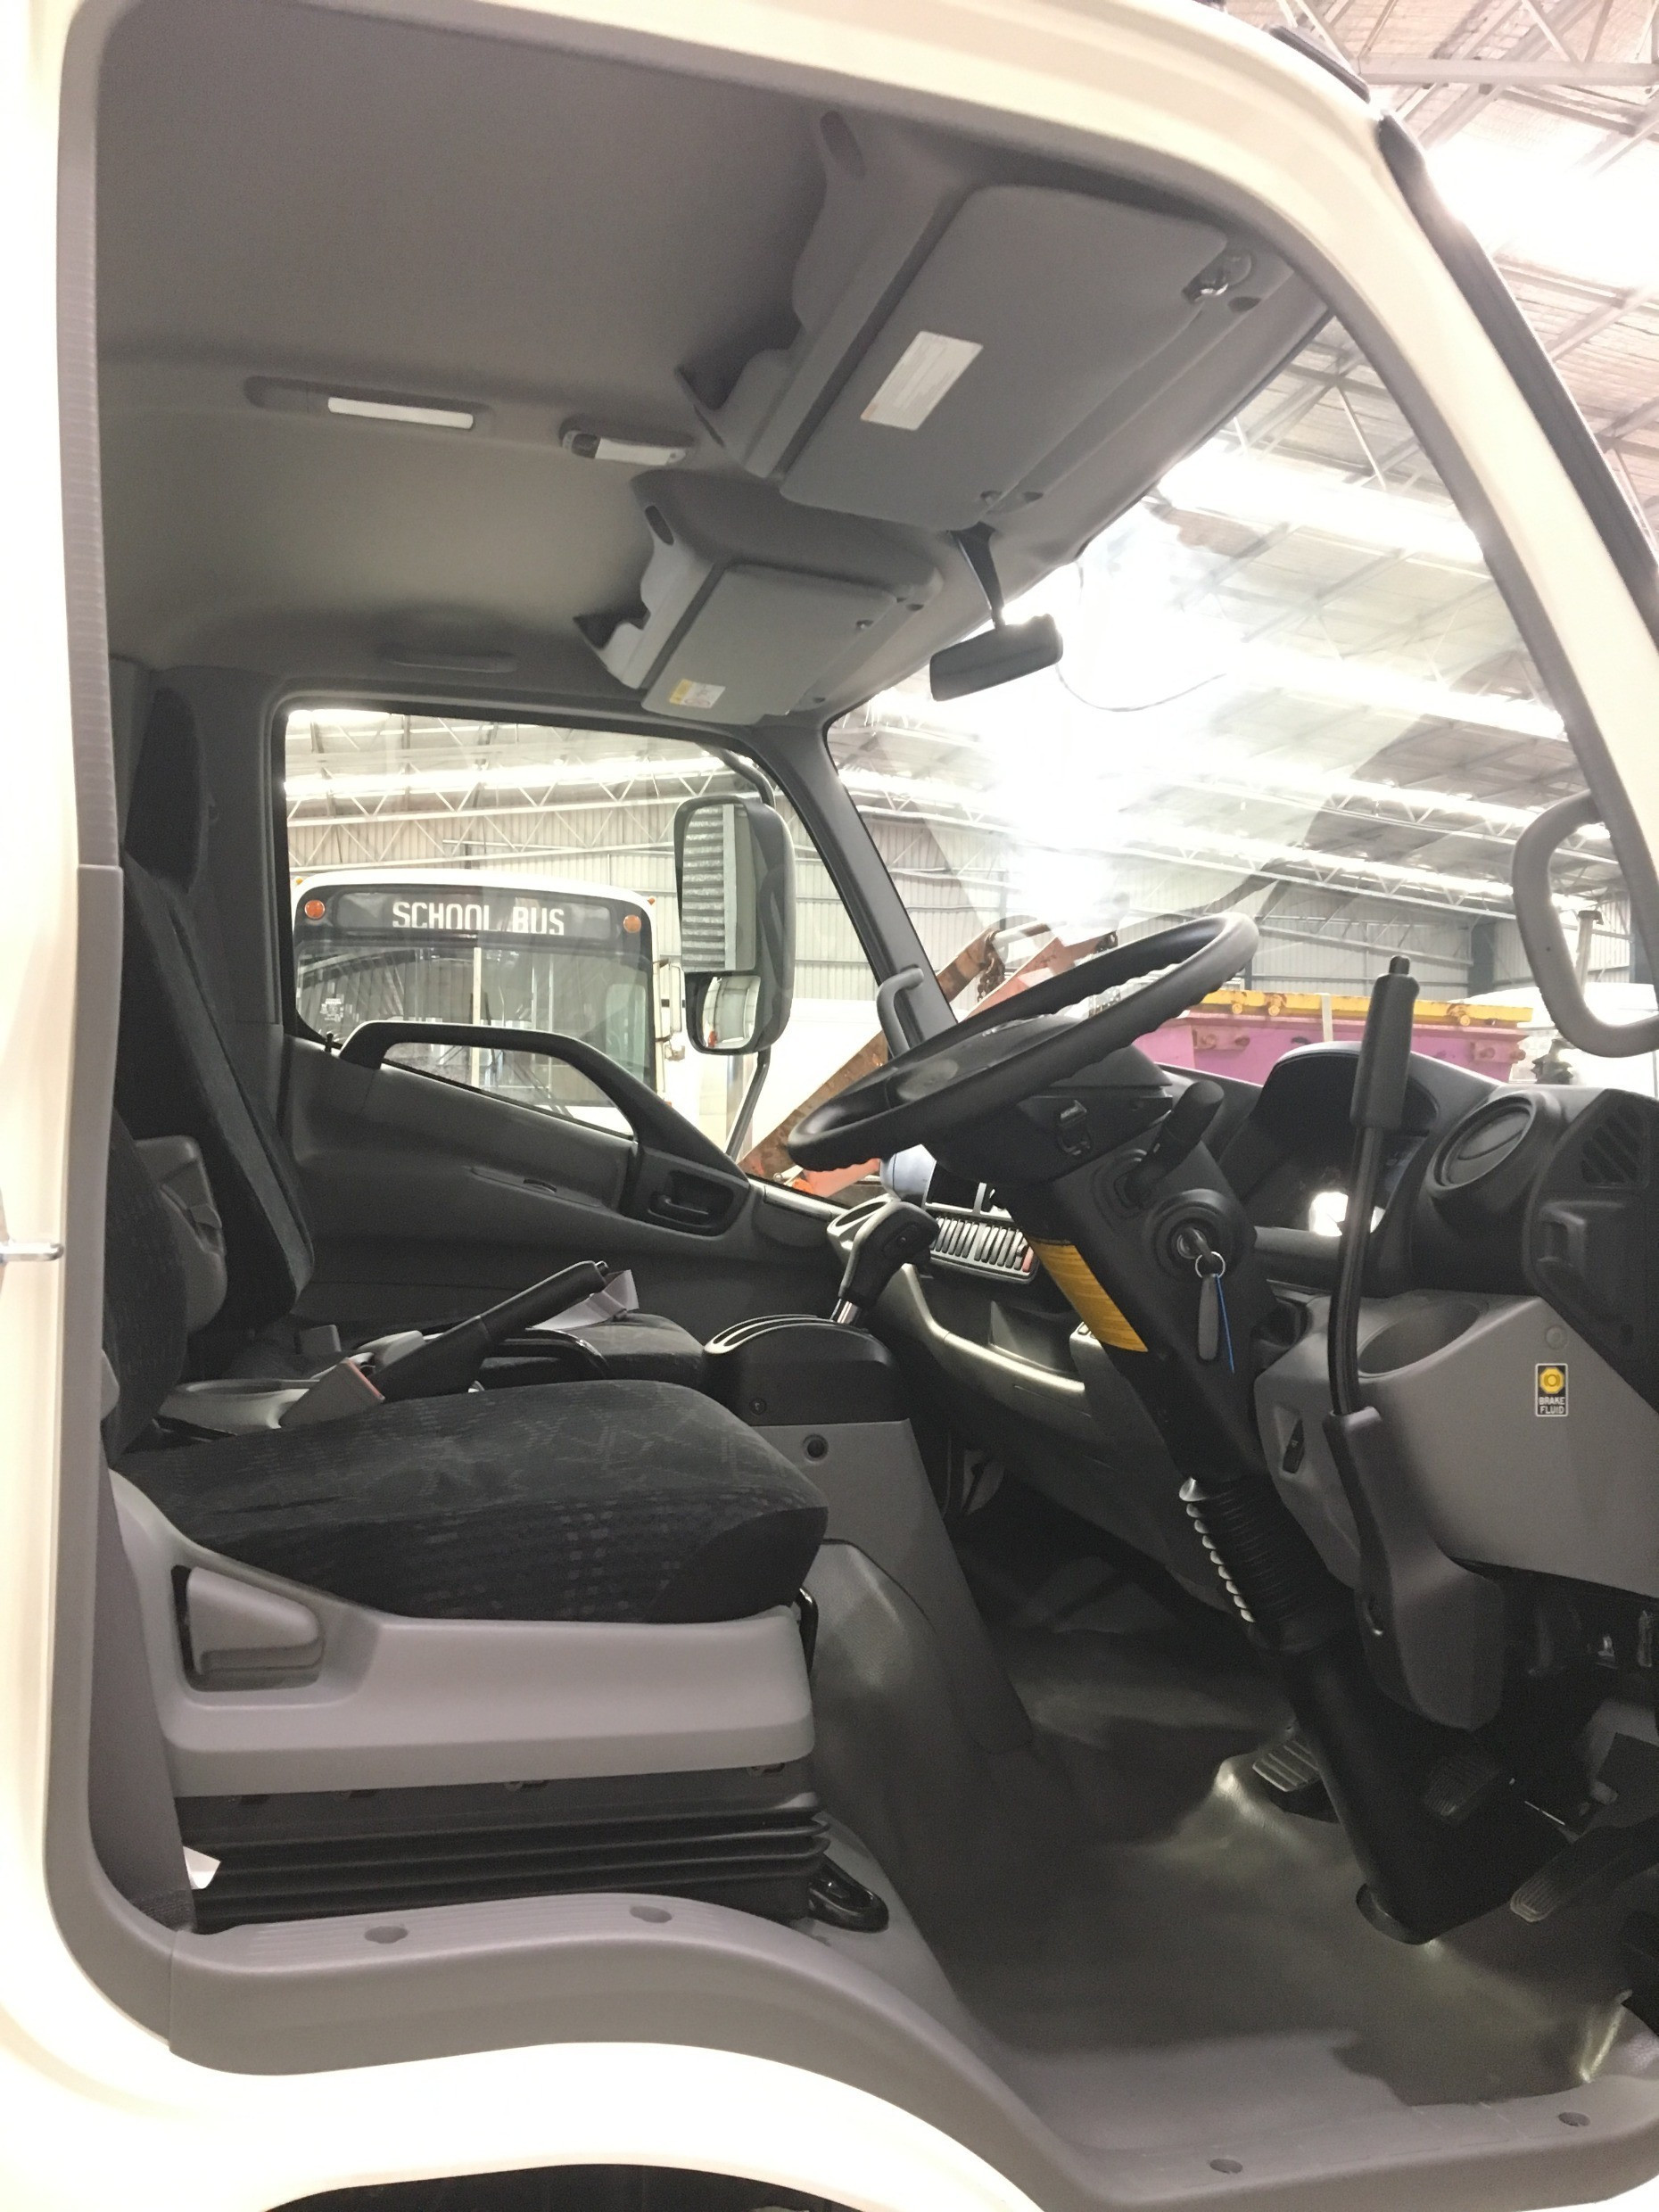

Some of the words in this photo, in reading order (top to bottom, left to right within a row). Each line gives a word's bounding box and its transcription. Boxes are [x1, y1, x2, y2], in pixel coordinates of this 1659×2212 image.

[512, 906, 565, 936] BUS
[1539, 1396, 1565, 1406] BRAKE
[1539, 1405, 1564, 1415] FLUID
